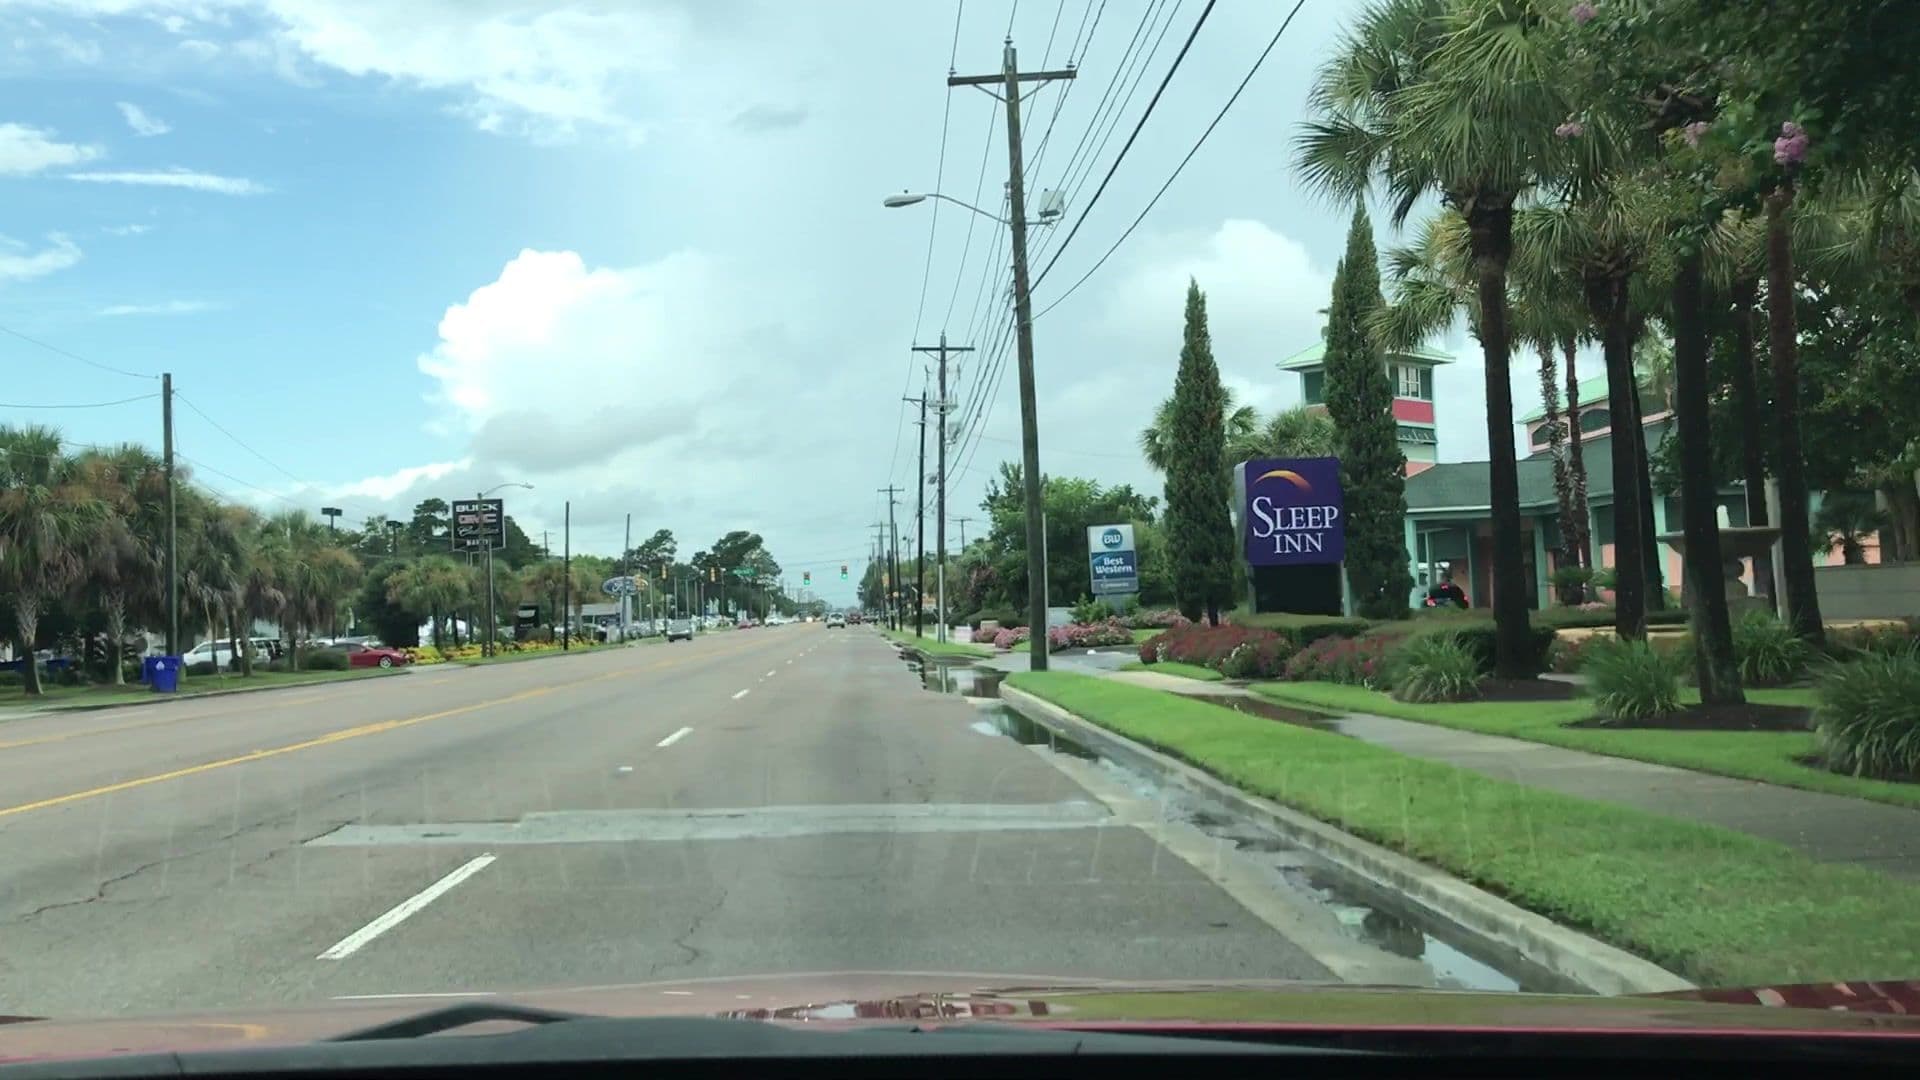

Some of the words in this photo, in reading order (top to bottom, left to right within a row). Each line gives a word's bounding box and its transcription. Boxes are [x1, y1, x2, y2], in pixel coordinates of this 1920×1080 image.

[1252, 496, 1339, 538] SLEEP
[1273, 532, 1324, 554] INN
[1103, 557, 1124, 566] Best
[1095, 565, 1133, 574] Western
